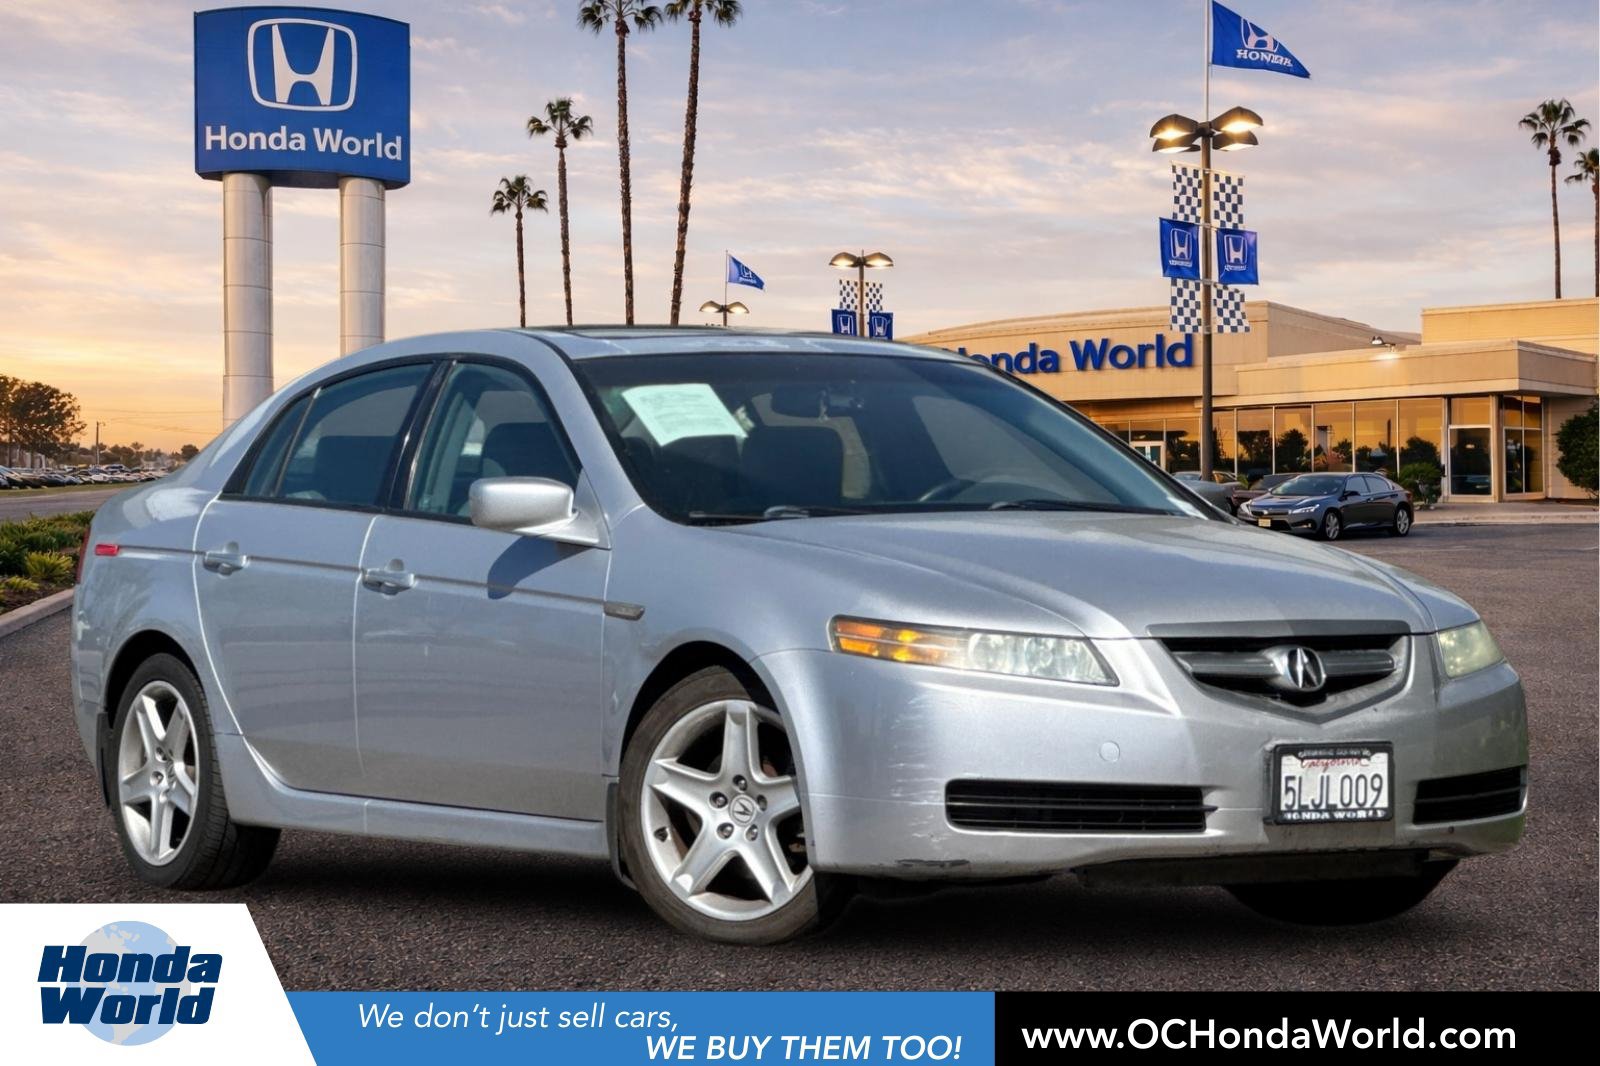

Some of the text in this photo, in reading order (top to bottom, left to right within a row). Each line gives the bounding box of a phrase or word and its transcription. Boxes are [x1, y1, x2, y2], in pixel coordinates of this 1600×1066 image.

[205, 125, 402, 161] Honda World
[942, 333, 1193, 374] nda World
[1284, 773, 1383, 809] 5LJL009
